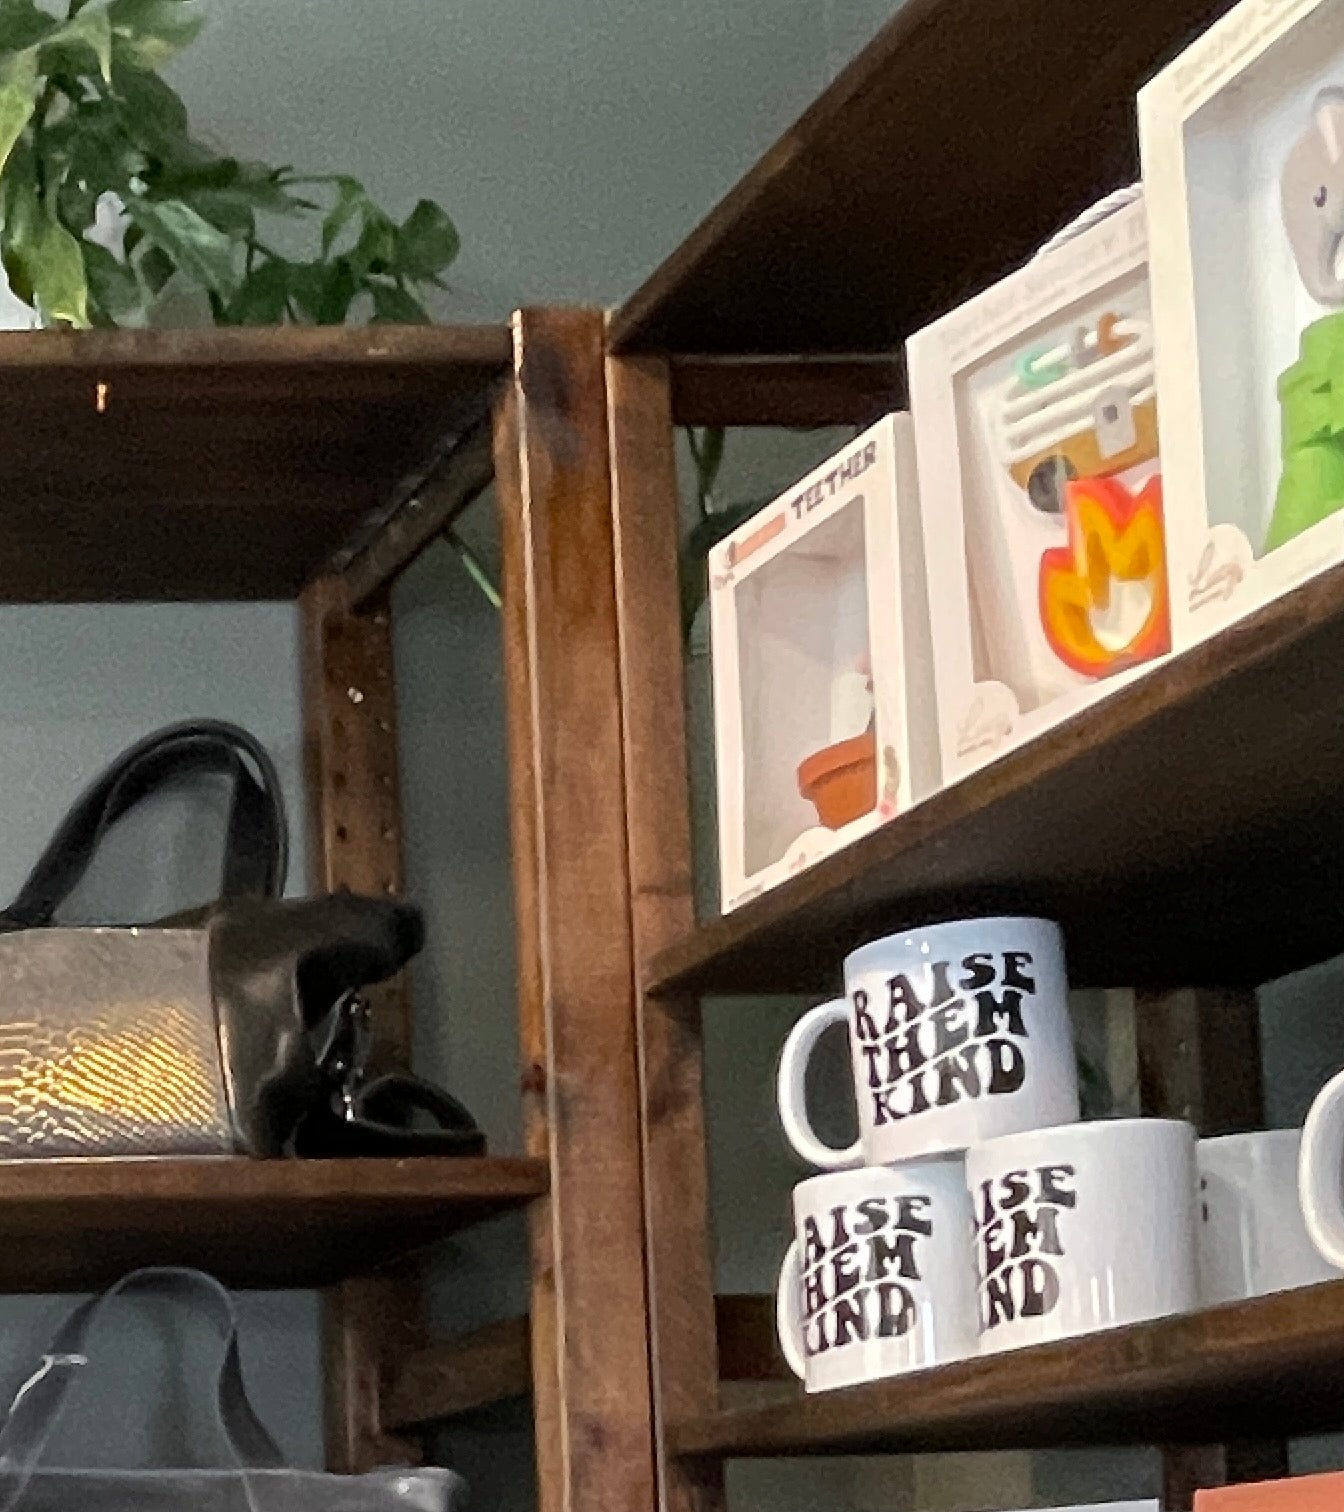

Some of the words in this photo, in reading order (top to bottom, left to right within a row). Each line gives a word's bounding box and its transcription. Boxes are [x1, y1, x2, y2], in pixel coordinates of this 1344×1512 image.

[791, 440, 878, 520] TEETHER
[852, 951, 1037, 1041] RAISE
[862, 988, 1030, 1088] THEM
[872, 1038, 1026, 1126] KIND
[803, 1195, 932, 1268] AISE
[973, 1164, 1077, 1232] ISE
[803, 1233, 921, 1316] HEM
[976, 1206, 1065, 1277] EM
[979, 1258, 1060, 1332] ND
